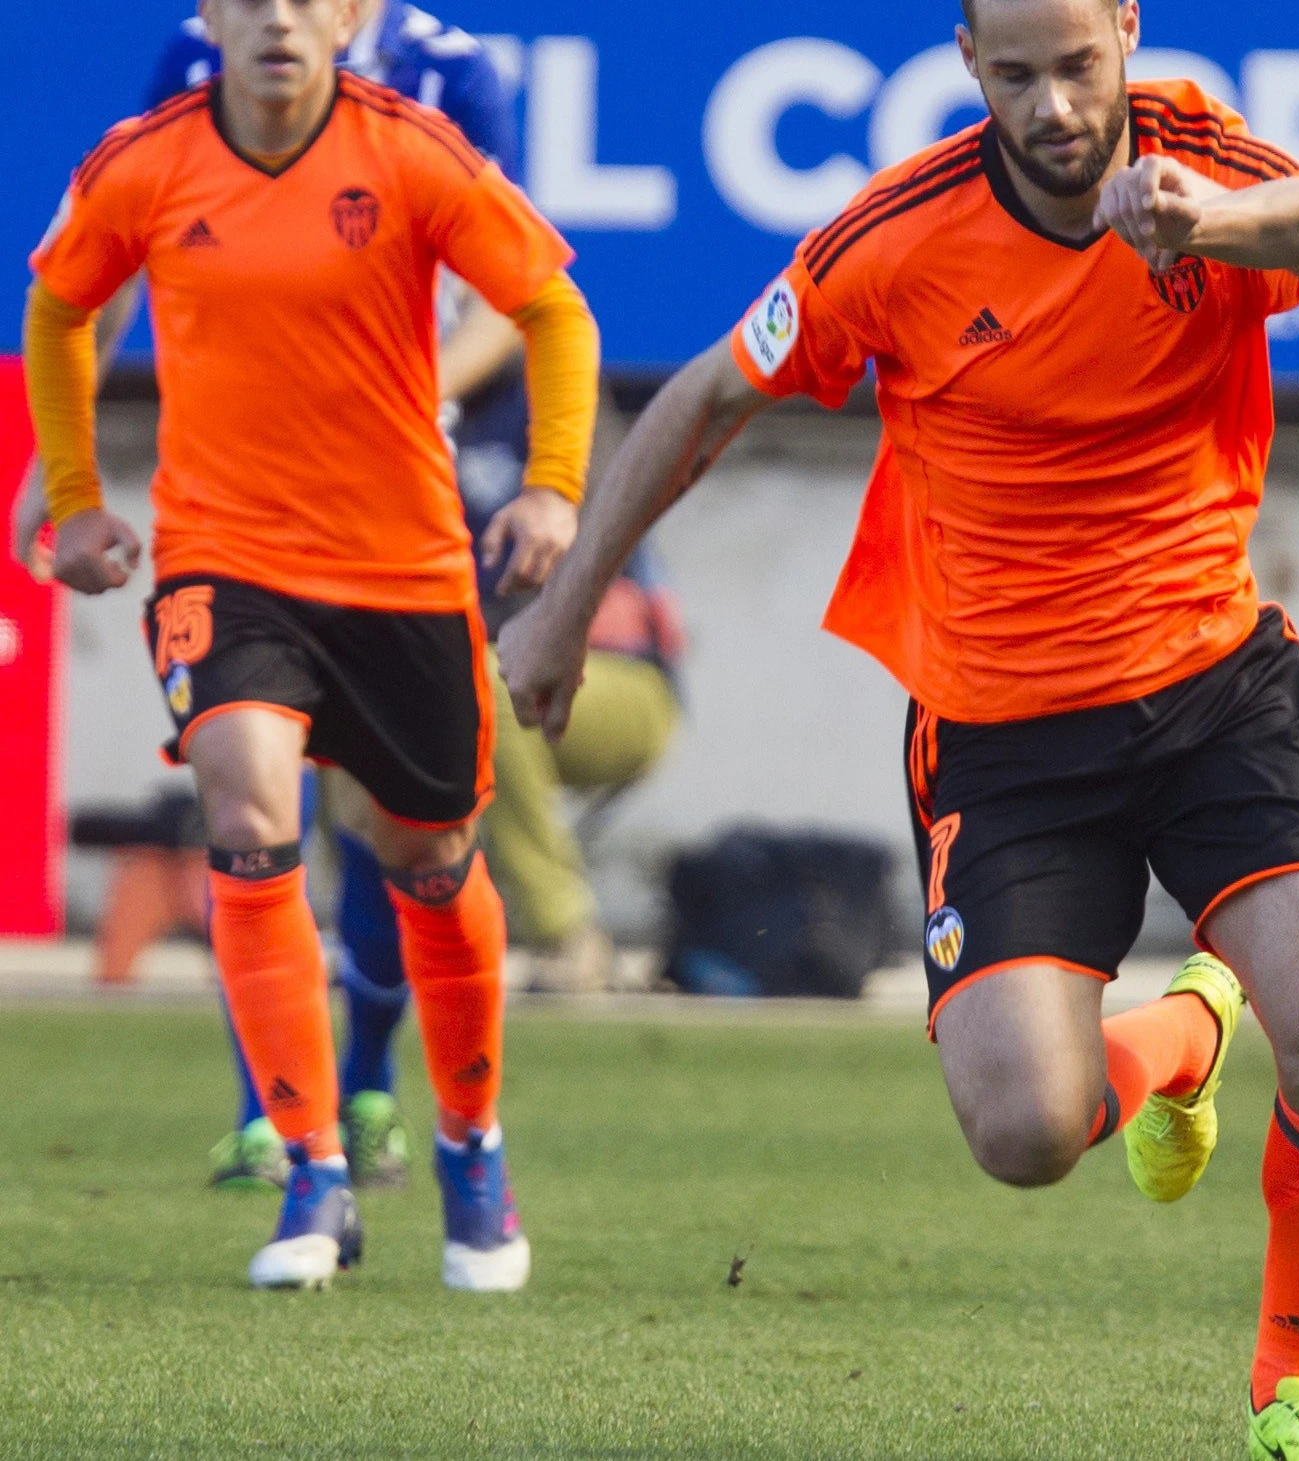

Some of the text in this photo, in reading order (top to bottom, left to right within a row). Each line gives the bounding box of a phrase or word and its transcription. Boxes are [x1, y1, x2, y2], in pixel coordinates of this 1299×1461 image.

[478, 33, 677, 231] L
[959, 329, 1012, 346] adidas
[155, 584, 215, 678] 15
[929, 812, 961, 915] 7
